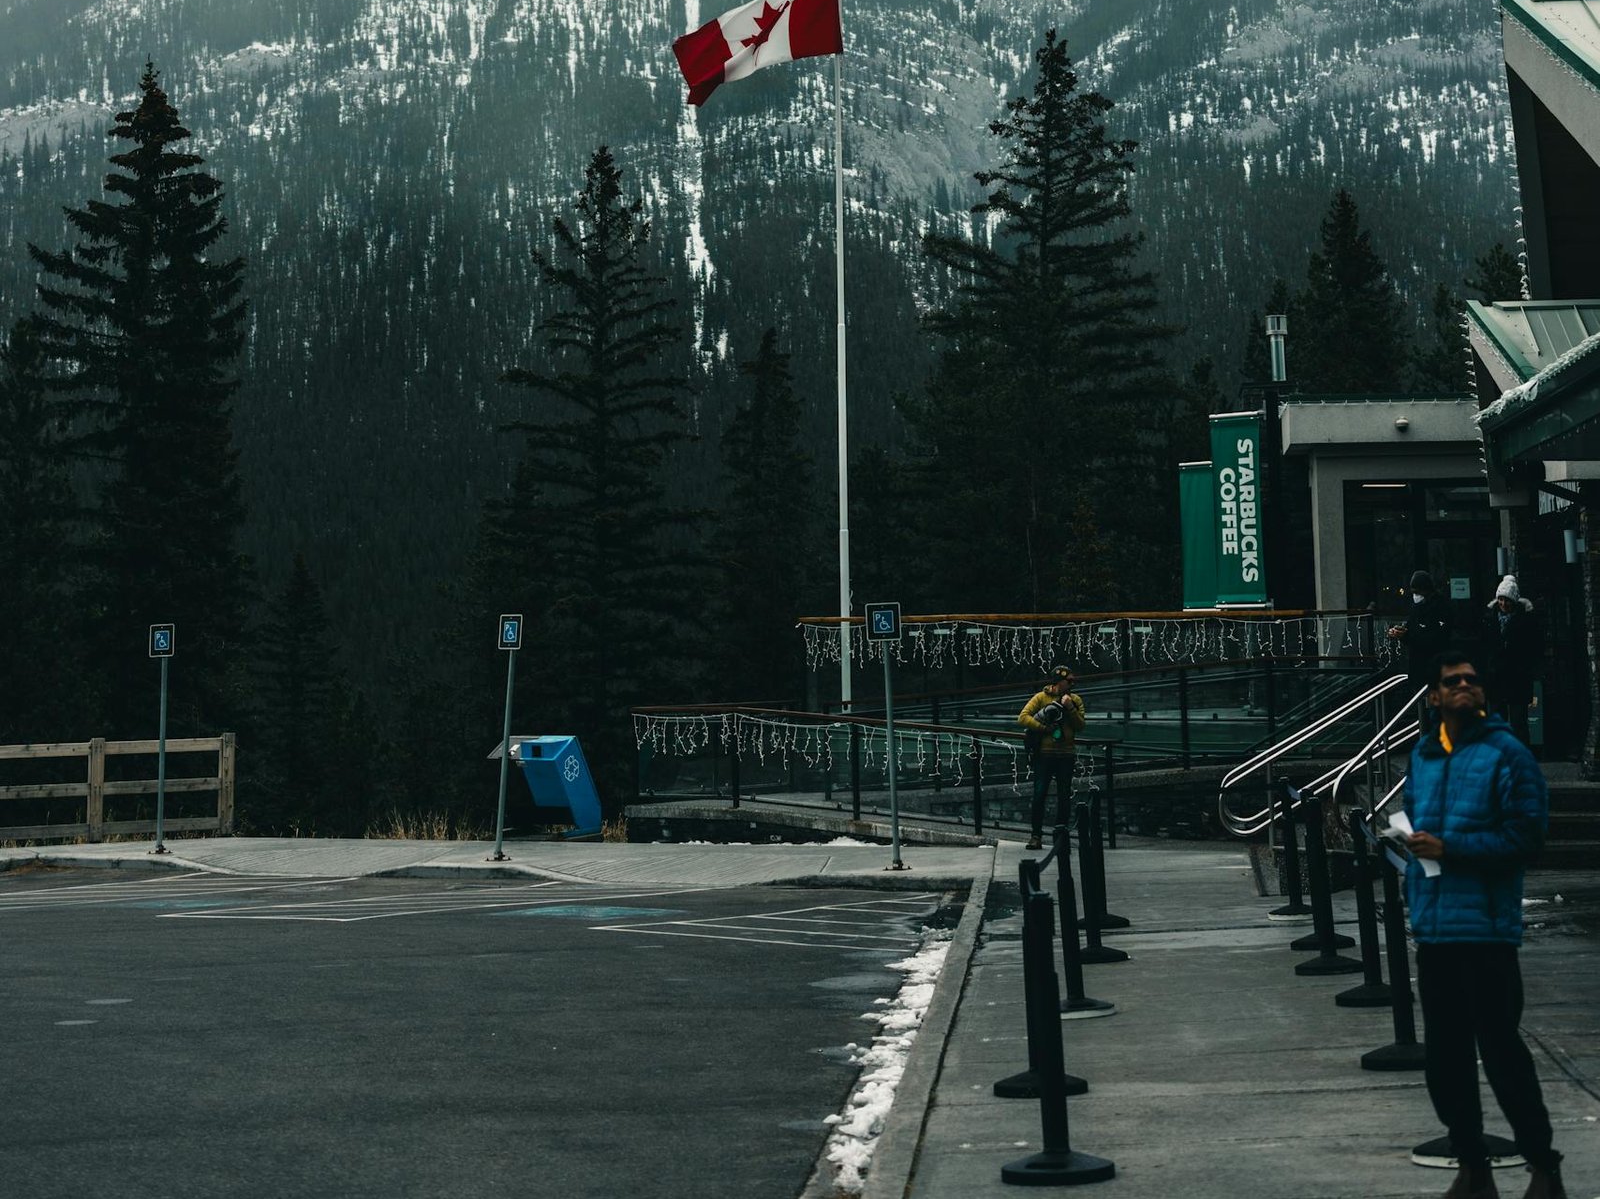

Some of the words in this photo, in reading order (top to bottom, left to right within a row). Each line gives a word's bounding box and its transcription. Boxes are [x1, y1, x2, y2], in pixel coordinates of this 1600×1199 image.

[1220, 467, 1238, 555] COFFEE
[1237, 438, 1258, 582] STARBUCKS
[875, 613, 881, 621] P
